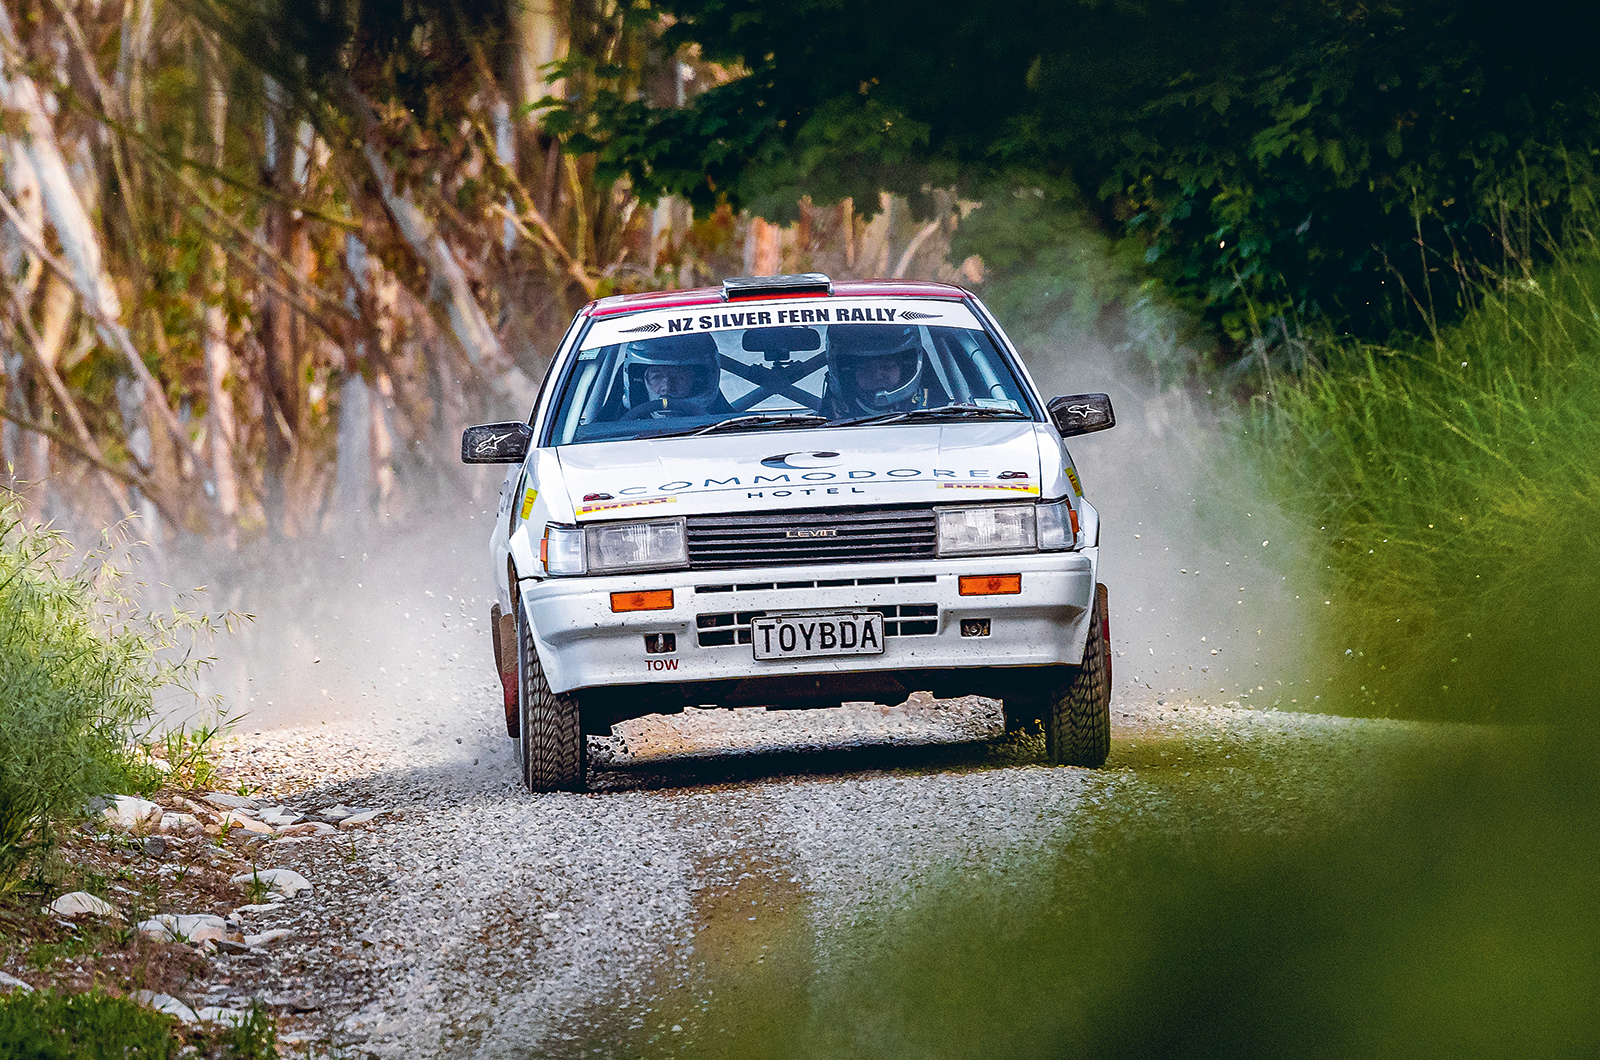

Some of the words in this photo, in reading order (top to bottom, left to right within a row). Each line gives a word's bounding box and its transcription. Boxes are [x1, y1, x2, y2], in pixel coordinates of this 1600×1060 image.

[668, 317, 694, 333] NZ
[699, 309, 772, 329] SILVER
[777, 308, 830, 324] FERN
[836, 307, 897, 322] RALLY
[617, 468, 991, 496] COMMODORE
[747, 487, 866, 499] HOTEL
[758, 619, 878, 653] TOYBDA
[645, 659, 680, 671] TOW
